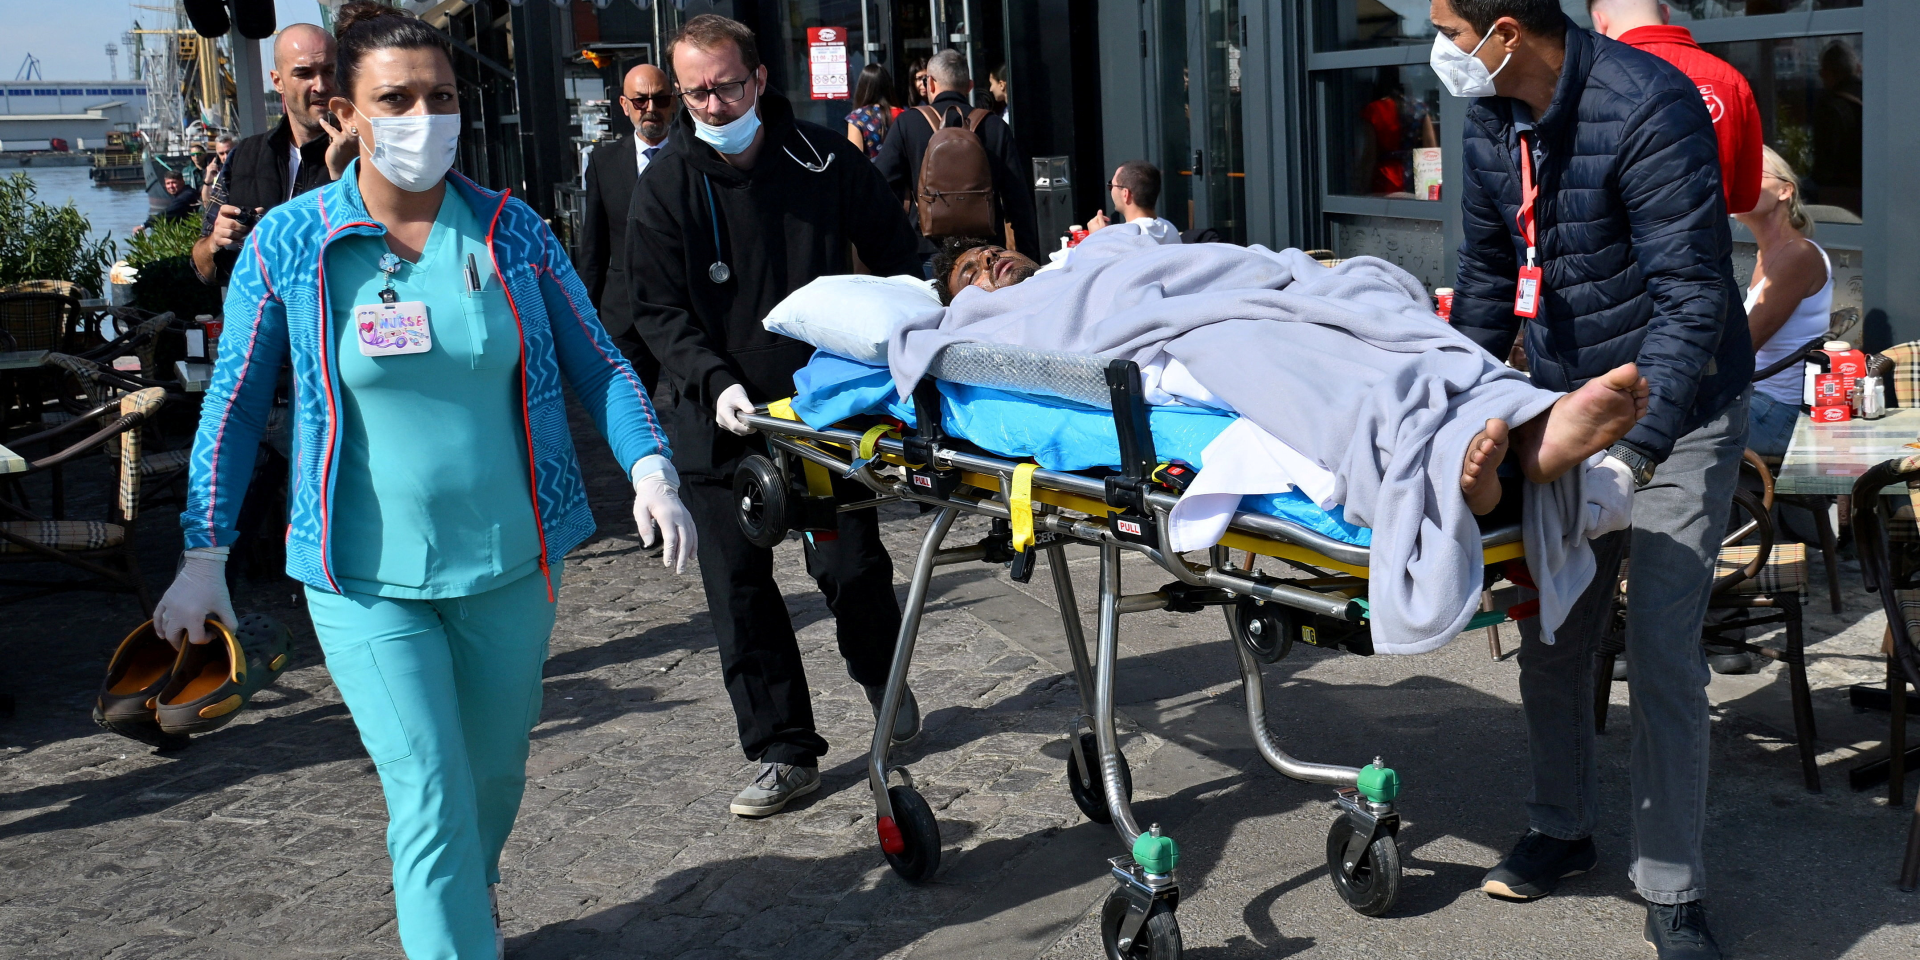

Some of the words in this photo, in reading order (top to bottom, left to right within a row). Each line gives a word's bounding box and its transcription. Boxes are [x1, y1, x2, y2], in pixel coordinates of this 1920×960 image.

[380, 315, 423, 329] NURSE
[915, 476, 930, 486] PULL
[1120, 522, 1139, 534] PULL
